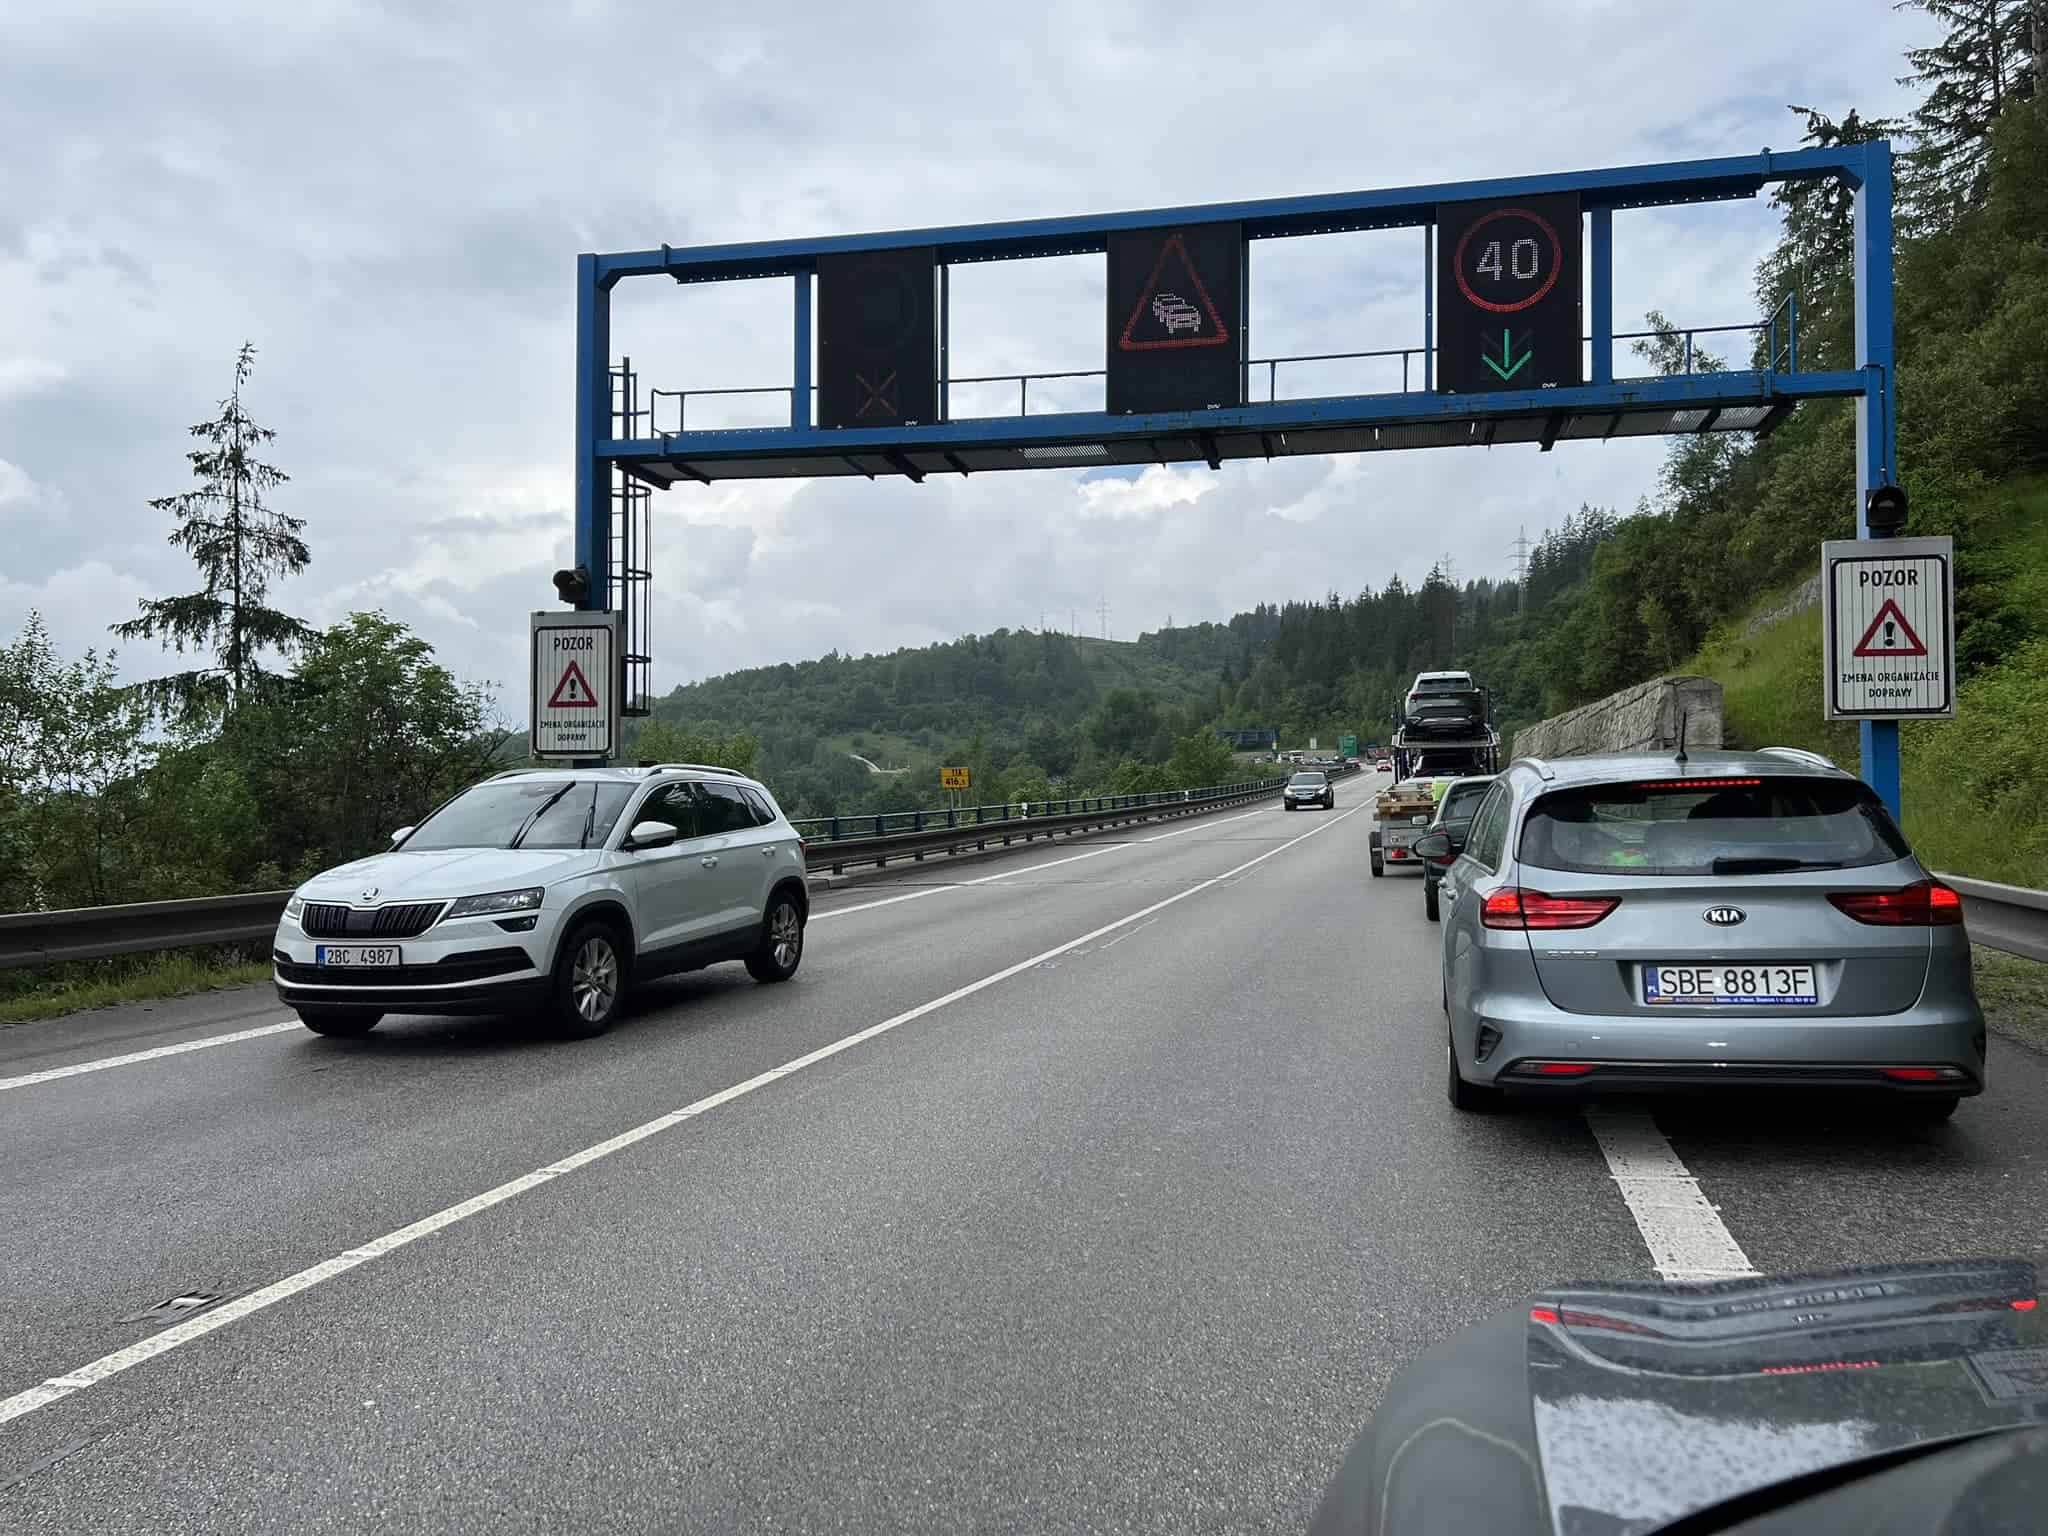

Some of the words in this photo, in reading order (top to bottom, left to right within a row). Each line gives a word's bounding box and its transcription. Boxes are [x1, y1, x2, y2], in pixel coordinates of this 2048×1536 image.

[1476, 239, 1538, 281] 40
[1859, 569, 1919, 587] POZOR
[553, 636, 593, 651] POZOR
[1841, 673, 1873, 683] ZMENA
[1868, 687, 1913, 698] DOPRAVY
[1711, 910, 1740, 922] KIA
[327, 949, 350, 964] 2BC
[360, 949, 394, 964] 4987
[1660, 968, 1714, 995] SBE
[1724, 968, 1809, 995] 8813F
